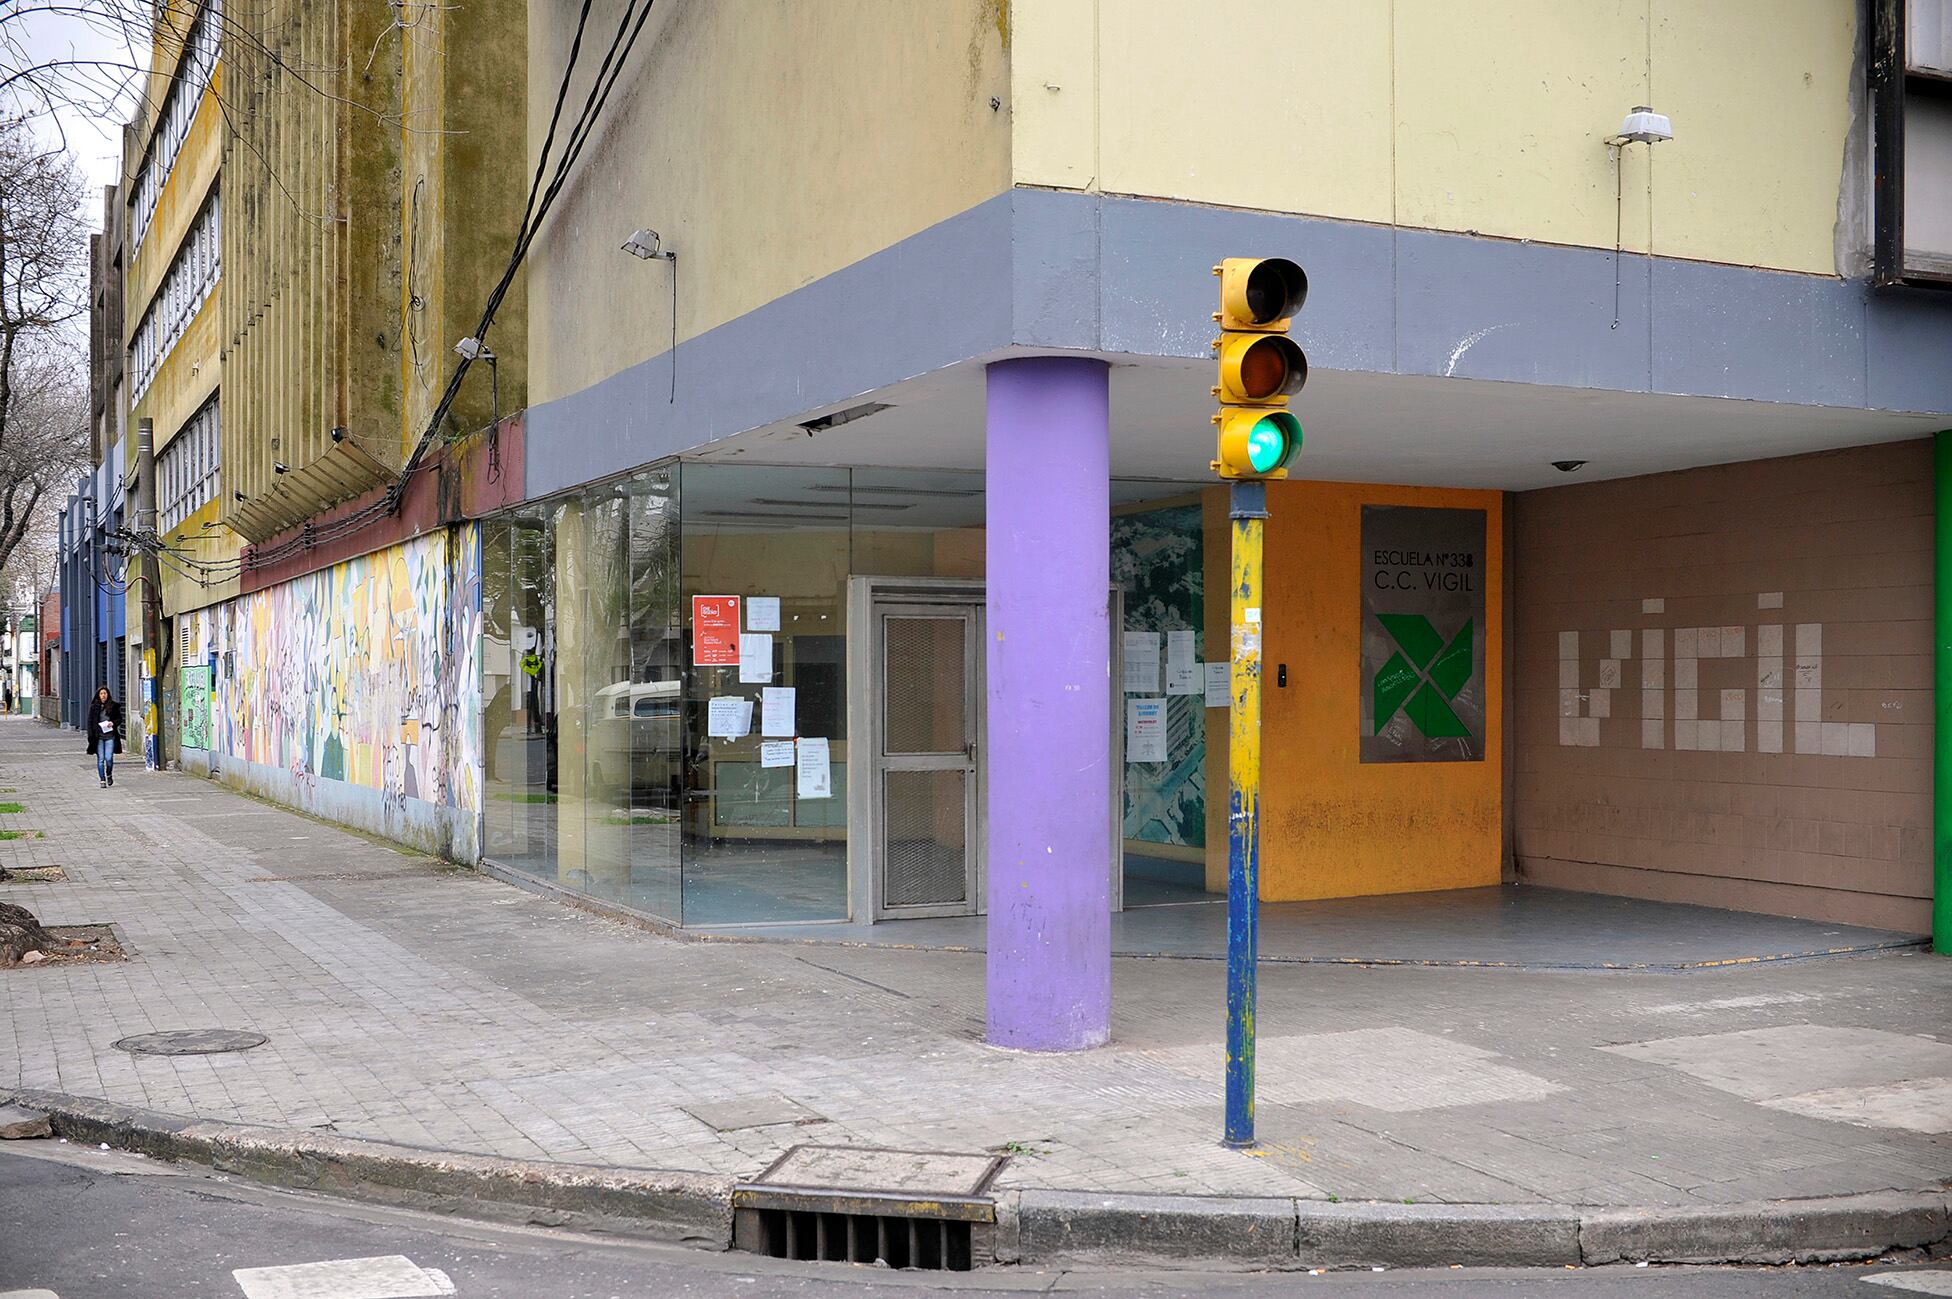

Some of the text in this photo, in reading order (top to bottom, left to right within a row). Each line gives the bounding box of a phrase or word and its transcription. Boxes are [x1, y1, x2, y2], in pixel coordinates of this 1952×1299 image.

[1374, 550, 1433, 566] ESCUELA
[1374, 570, 1474, 592] C.C. VIGIL
